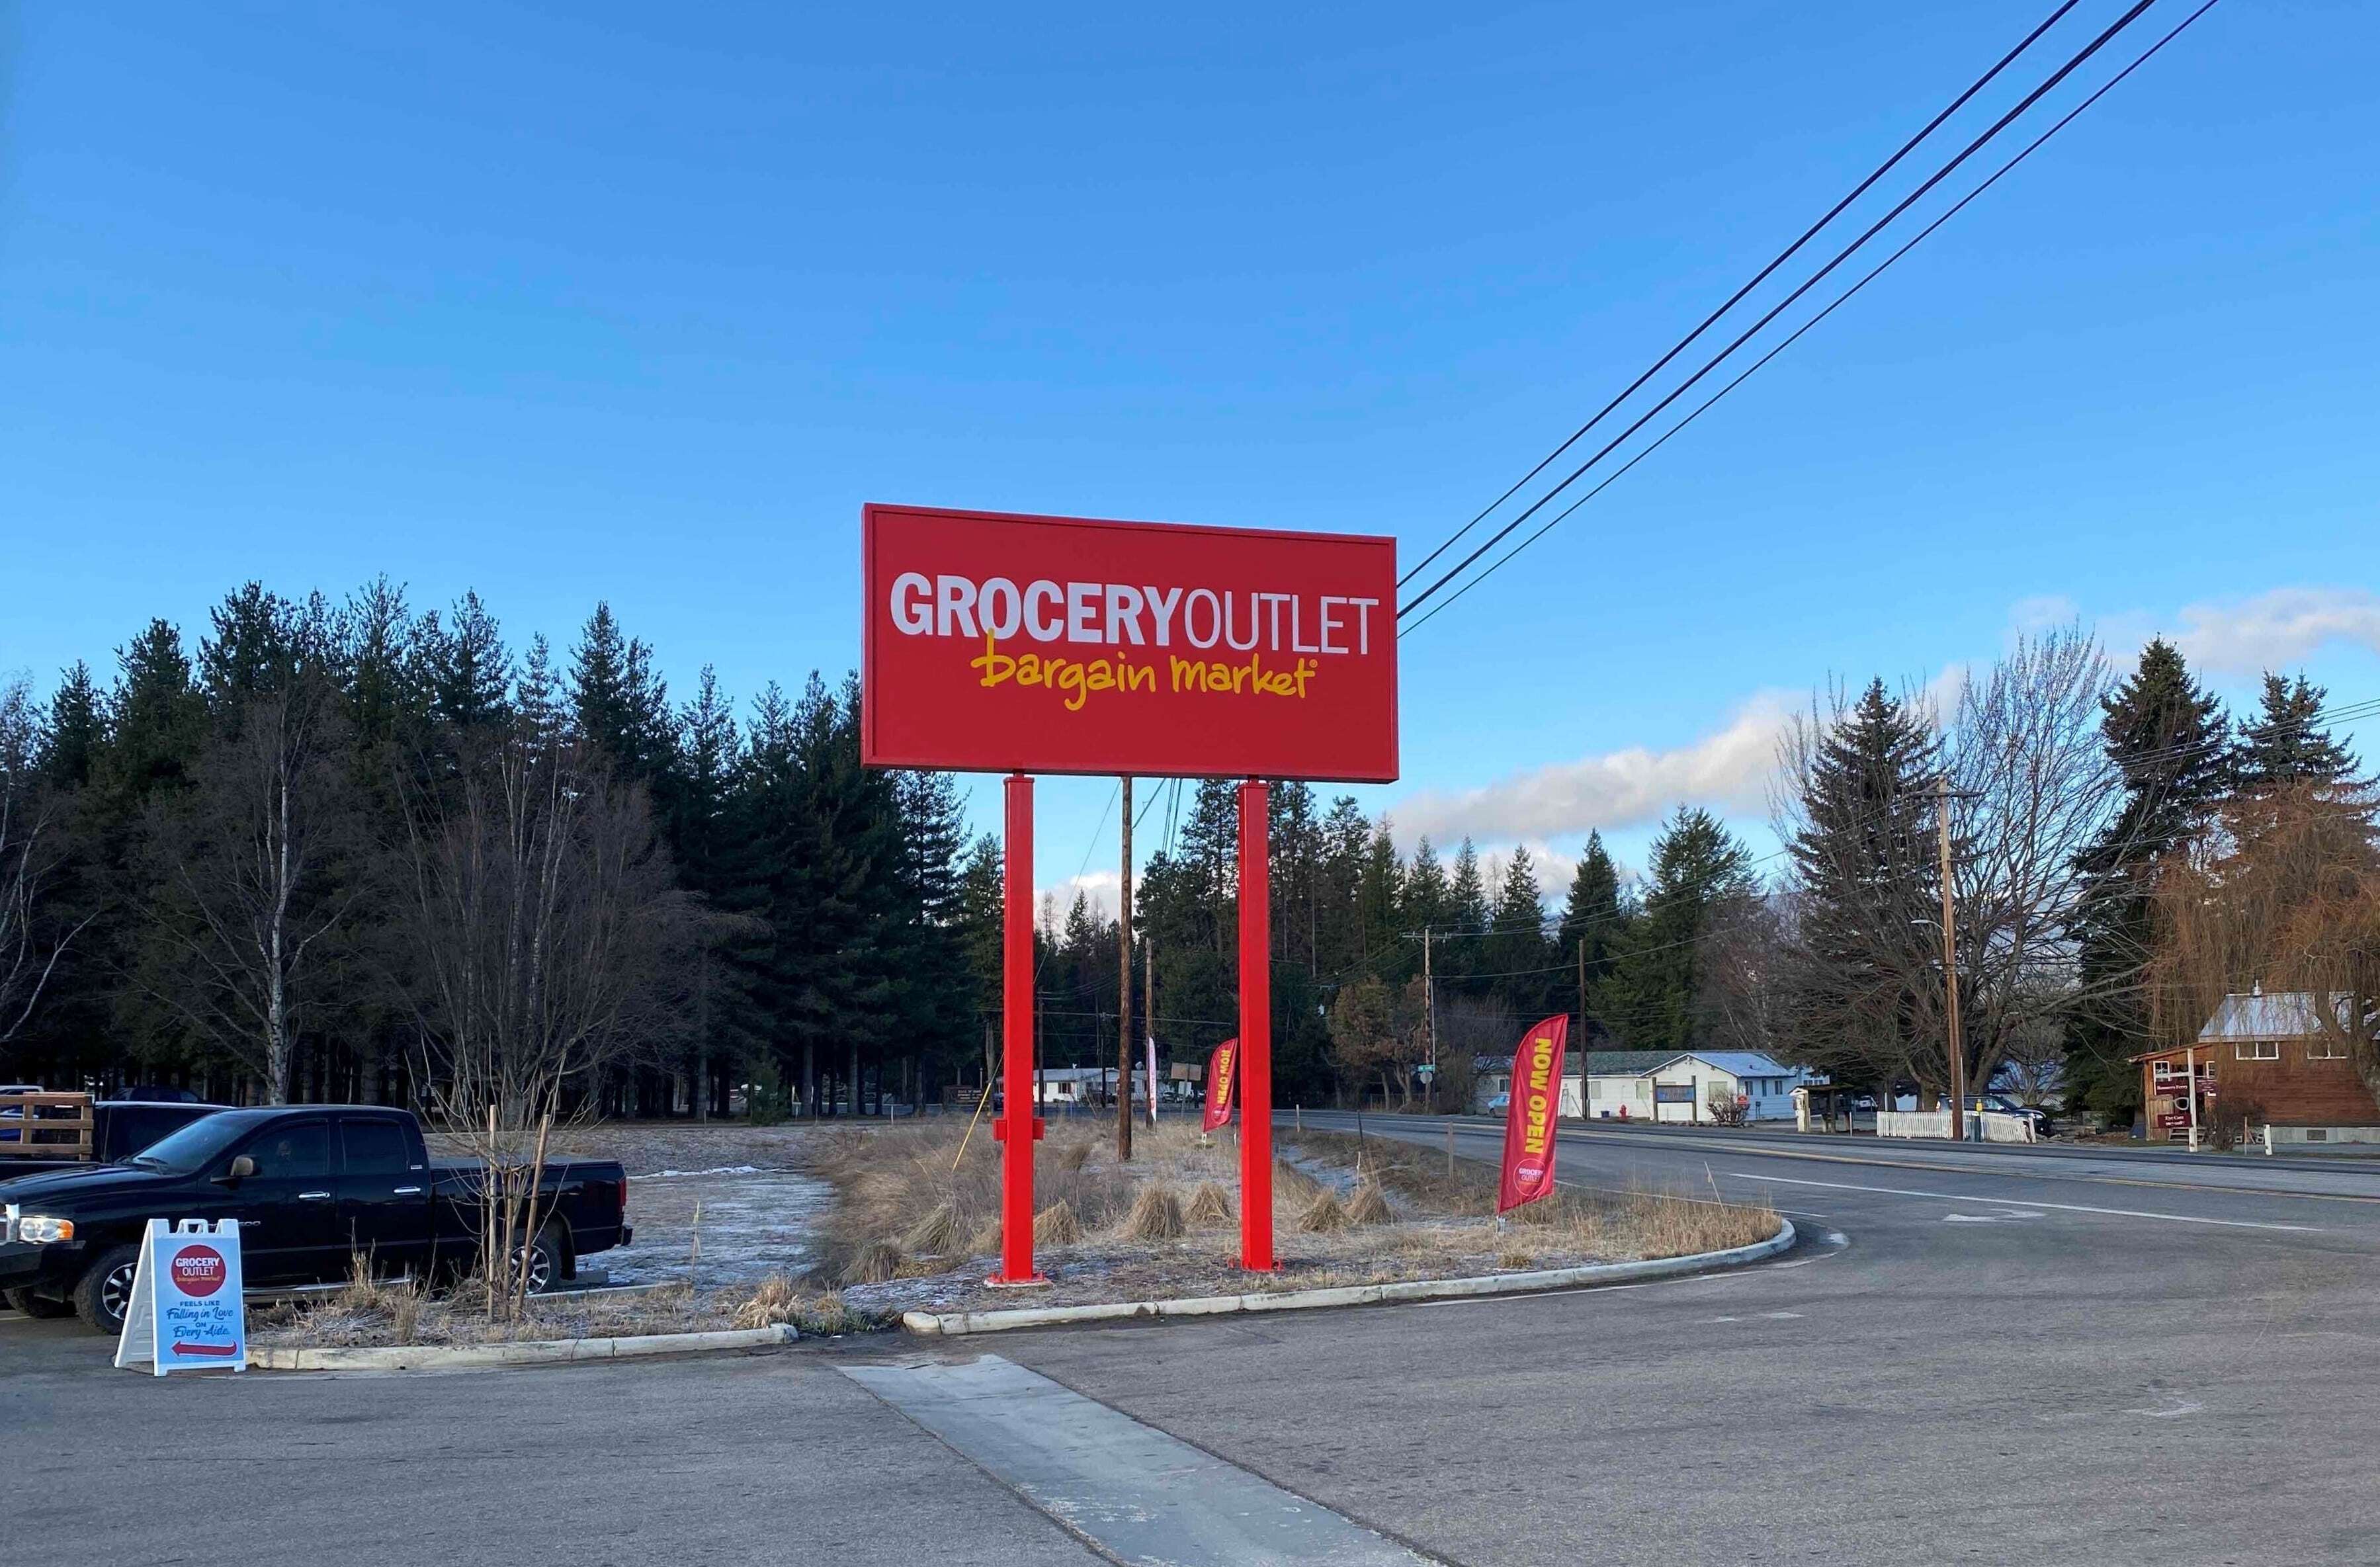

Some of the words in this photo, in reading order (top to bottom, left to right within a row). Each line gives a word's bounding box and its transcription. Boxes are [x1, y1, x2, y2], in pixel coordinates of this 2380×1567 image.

[971, 628, 1156, 711] bargain
[1219, 1049, 1232, 1074] NOW
[1529, 1037, 1552, 1091] NOW
[1216, 1076, 1229, 1105] OPEN
[1525, 1095, 1548, 1154] OPEN
[175, 1257, 220, 1267] GROCERY
[182, 1267, 215, 1276] OUTLET
[167, 1308, 199, 1322] Falling
[200, 1309, 210, 1318] in
[212, 1307, 234, 1320] Love
[173, 1326, 202, 1339] Every
